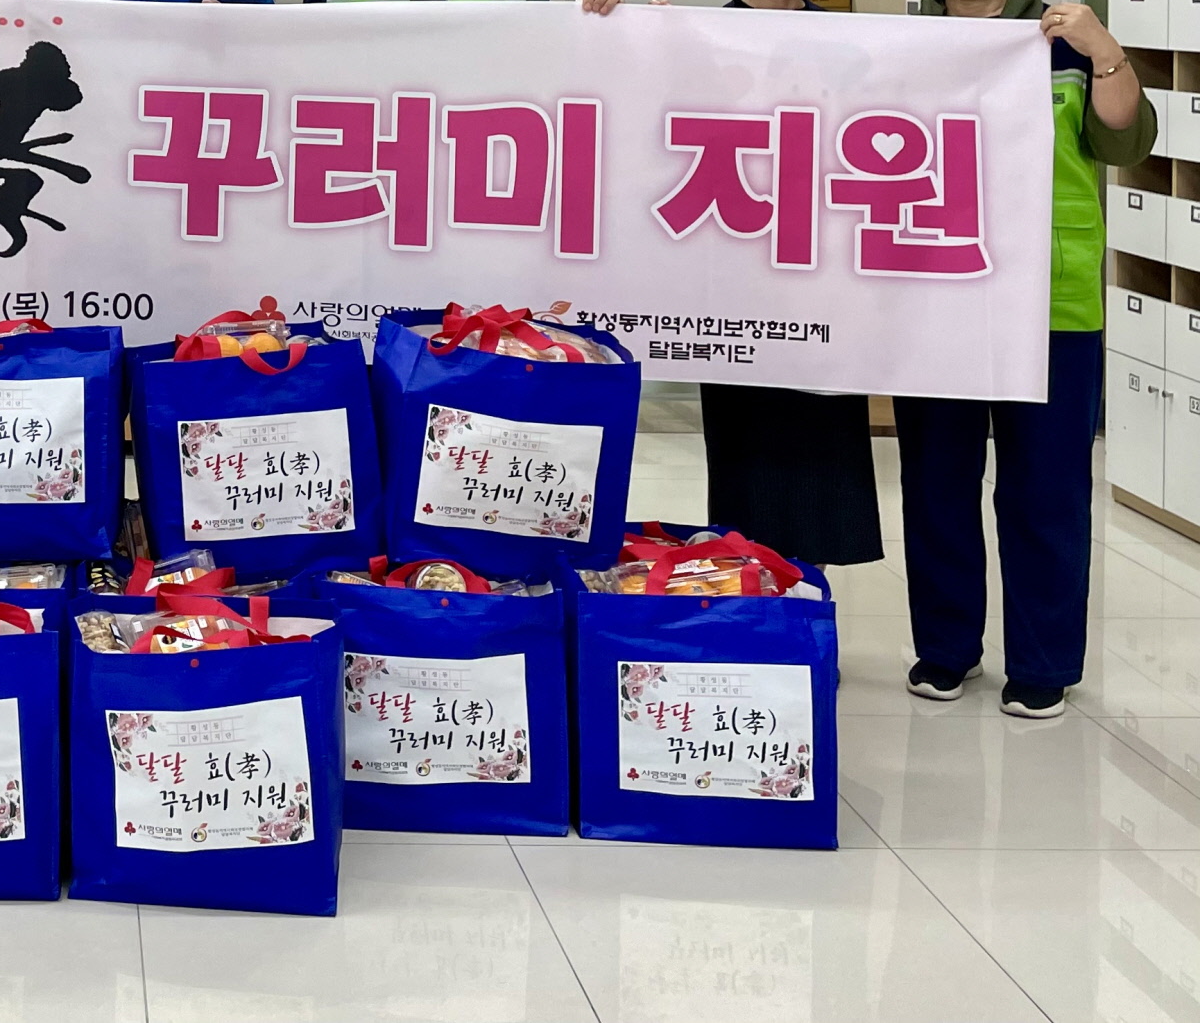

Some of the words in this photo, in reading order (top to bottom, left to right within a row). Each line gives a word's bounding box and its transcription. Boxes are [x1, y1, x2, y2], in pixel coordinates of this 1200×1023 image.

[129, 85, 601, 259] 꾸러미
[652, 105, 993, 278] 지원
[63, 291, 153, 320] 16:00
[293, 302, 421, 328] 사랑의열
[649, 341, 755, 363] 달달복지단
[25, 447, 63, 471] 지원
[204, 452, 248, 482] 달달
[263, 451, 320, 476] 효(孝)
[448, 446, 494, 474] 달달
[508, 456, 567, 485] 효(孝)
[225, 483, 283, 510] 꾸러미
[295, 479, 332, 502] 지원
[463, 477, 523, 504] 꾸러미
[534, 489, 574, 511] 지원
[368, 691, 416, 723] 달달
[433, 697, 494, 725] 효(孝)
[645, 701, 695, 732] 달달
[713, 705, 777, 735] 효(孝)
[389, 728, 453, 753] 꾸러미
[466, 729, 506, 753] 지원
[667, 737, 734, 764] 꾸러미
[747, 742, 789, 766] 지원
[136, 752, 187, 784] 달달
[205, 749, 271, 781] 효(孝)
[160, 788, 228, 818] 꾸러미
[243, 782, 286, 809] 지원
